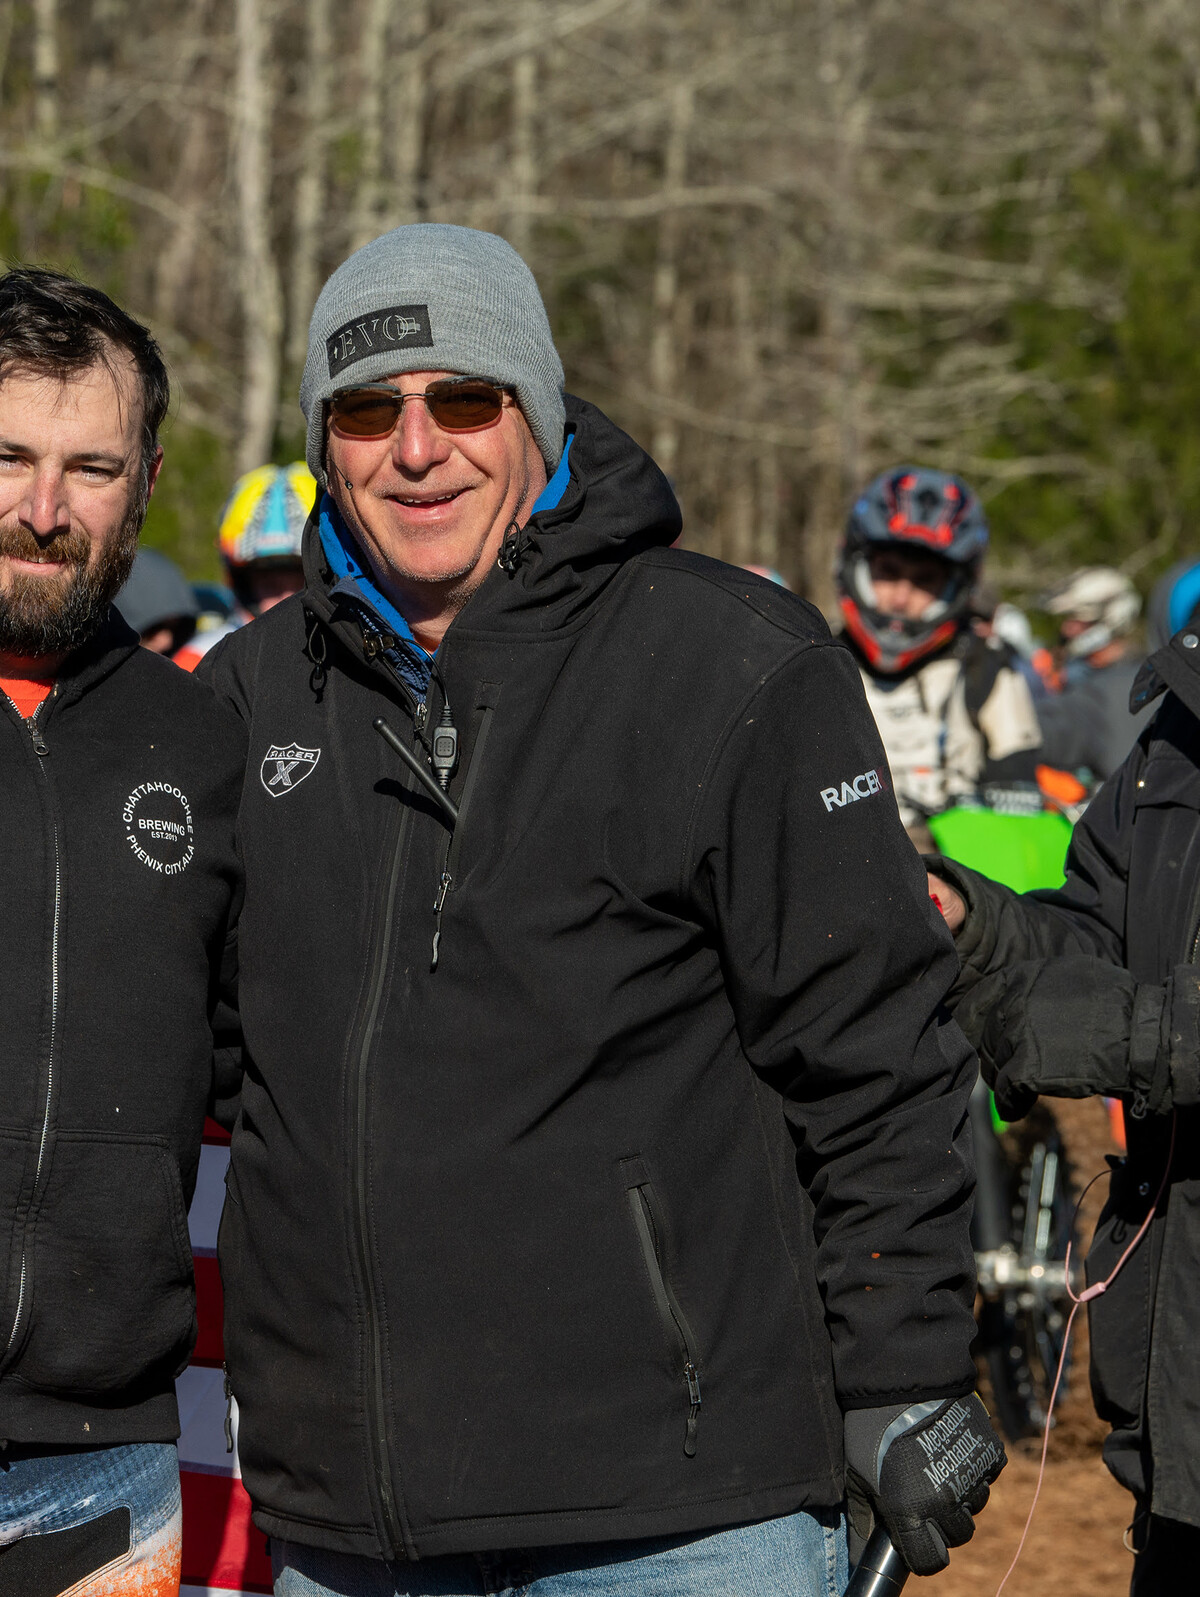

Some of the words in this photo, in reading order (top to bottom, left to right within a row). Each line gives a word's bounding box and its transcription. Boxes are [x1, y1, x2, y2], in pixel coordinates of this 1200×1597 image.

[270, 750, 315, 760] RACER
[268, 761, 300, 786] X
[122, 781, 194, 834] CHATTAHOOCHEE
[138, 818, 186, 837] BREWING
[126, 835, 163, 873] PHENIX
